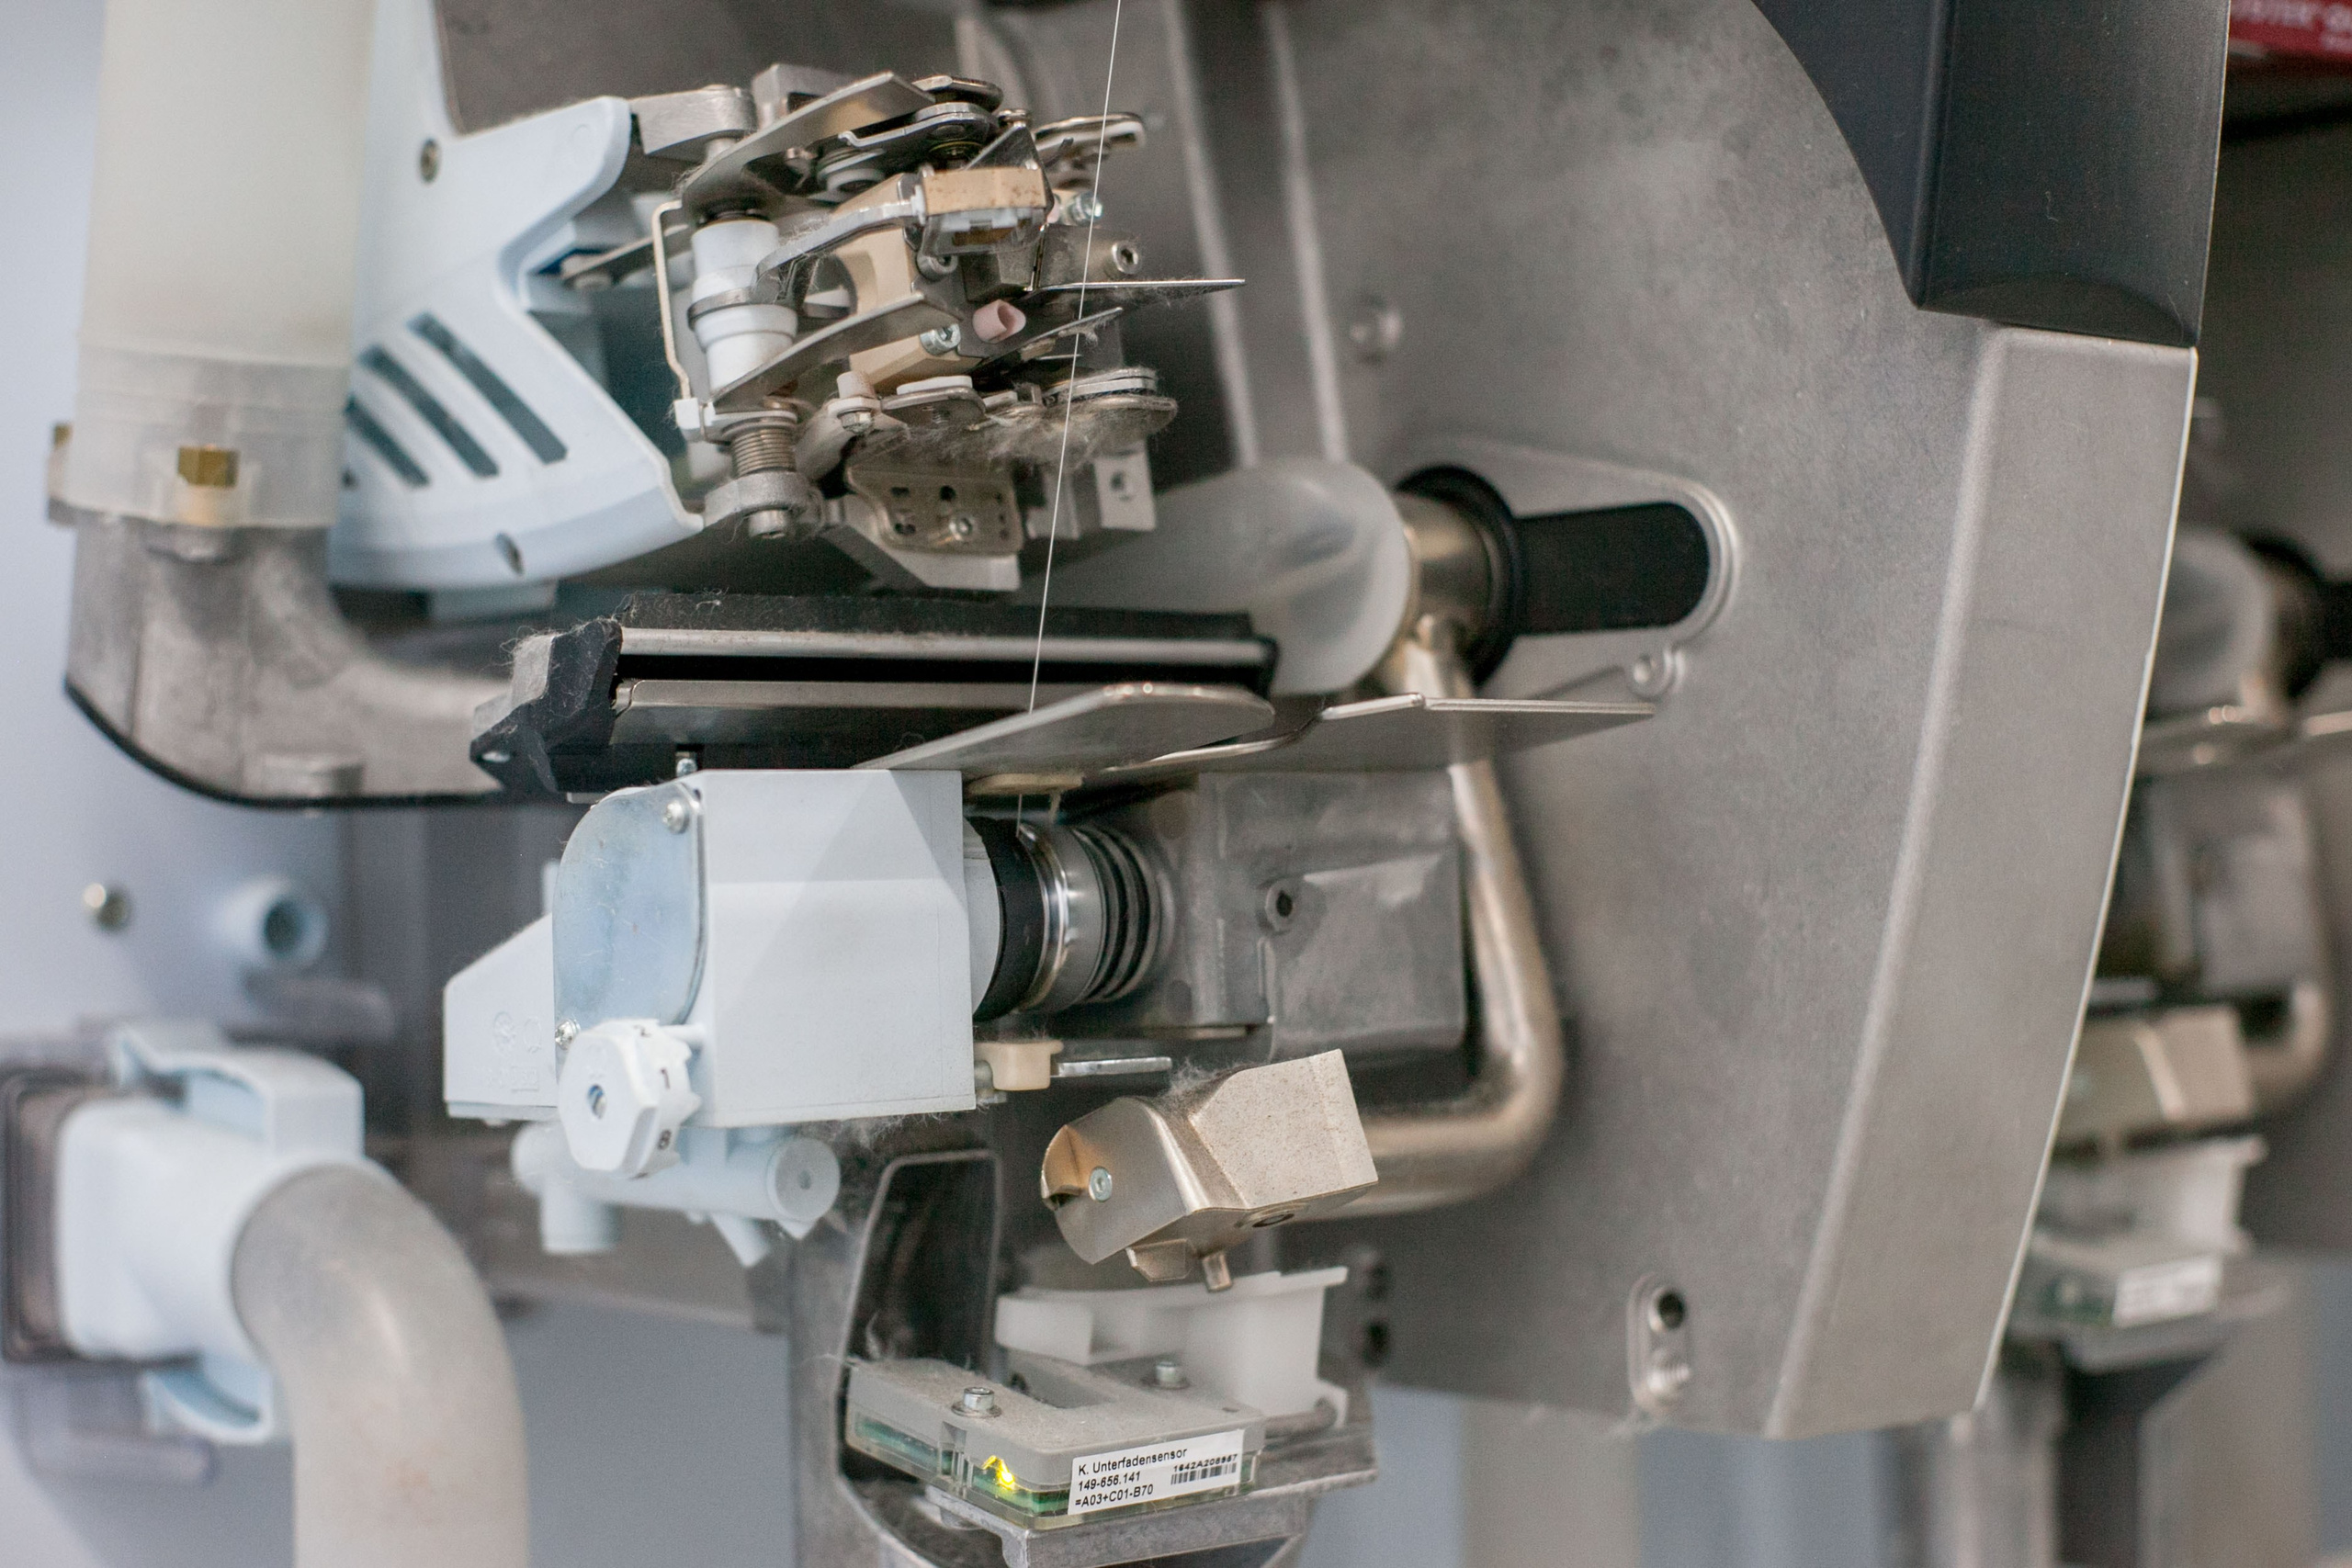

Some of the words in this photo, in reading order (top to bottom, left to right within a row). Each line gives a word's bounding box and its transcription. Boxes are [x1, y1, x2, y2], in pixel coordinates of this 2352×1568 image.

[1078, 1464, 1090, 1476] K.
[1092, 1448, 1188, 1473] Unterfadensensor
[1078, 1472, 1141, 1492] 149-656.141
[1075, 1483, 1154, 1507] =A03+C01-B70
